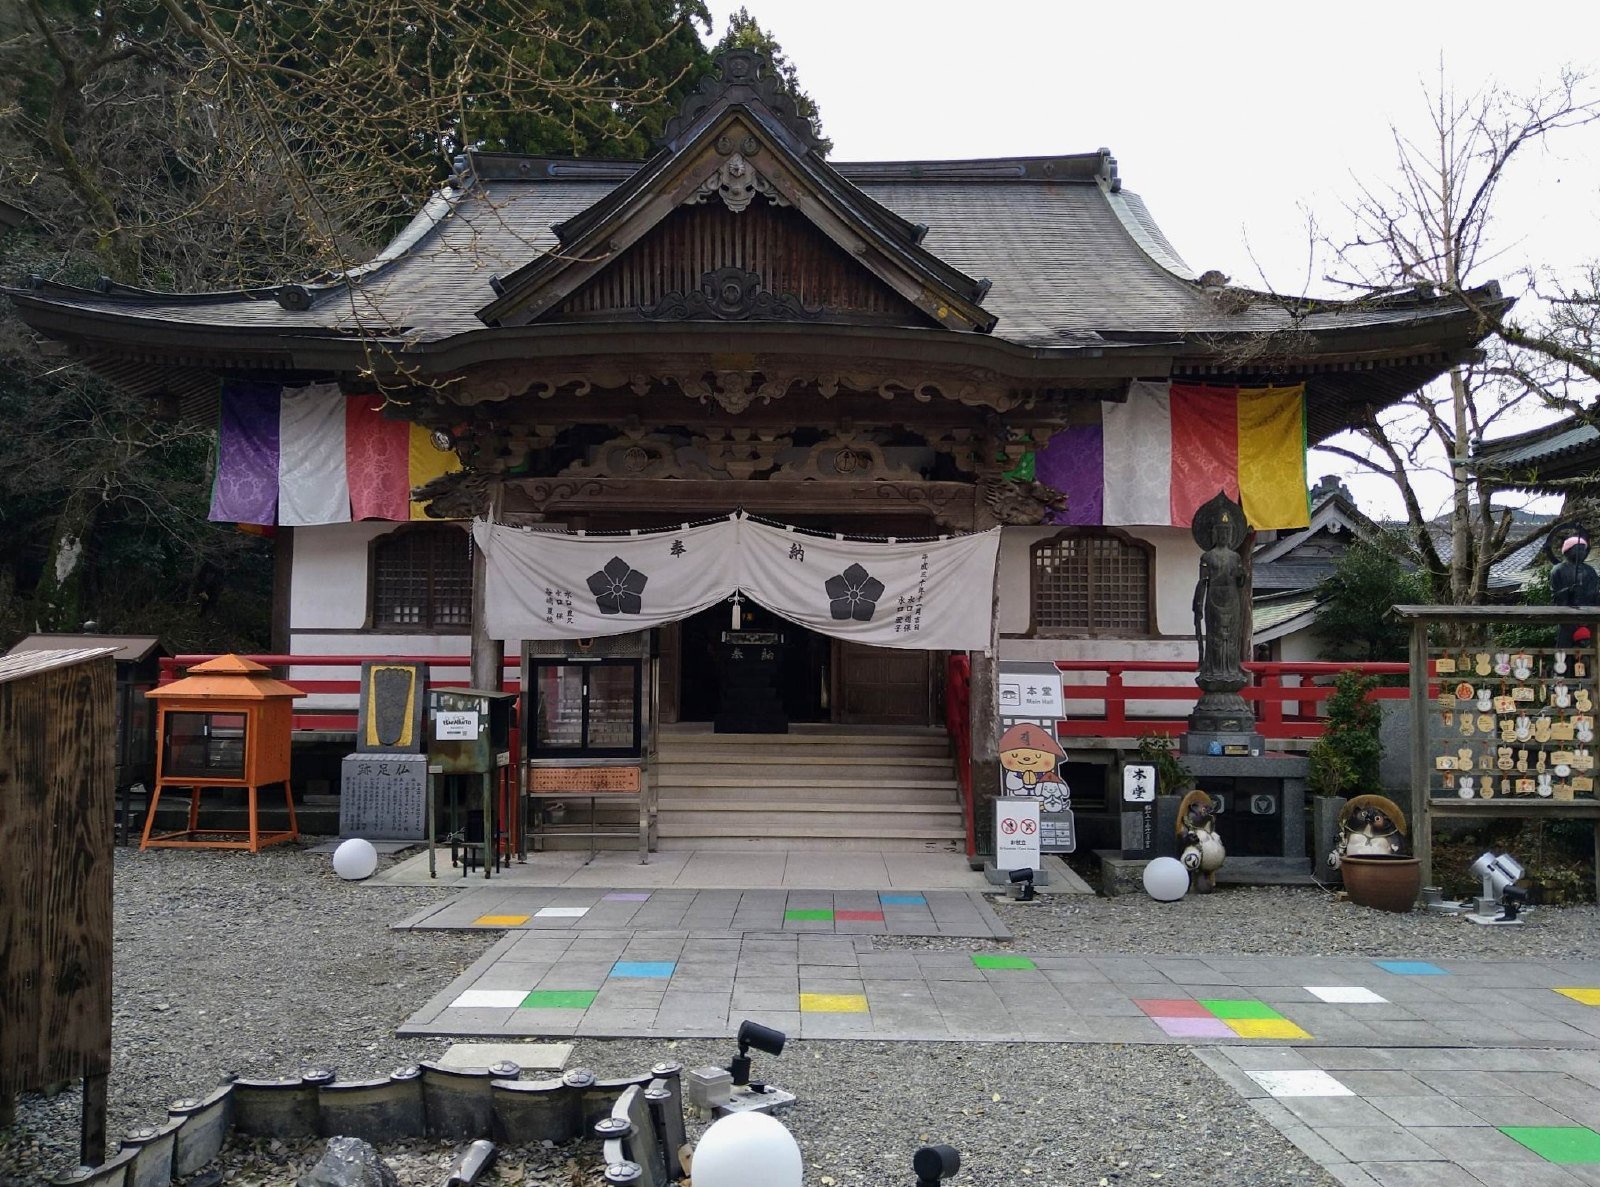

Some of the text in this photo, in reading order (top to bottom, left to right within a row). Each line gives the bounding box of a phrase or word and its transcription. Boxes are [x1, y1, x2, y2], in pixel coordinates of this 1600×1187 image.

[670, 539, 805, 563] 奉 納
[1026, 685, 1052, 697] 本堂
[1132, 767, 1147, 800] 本堂
